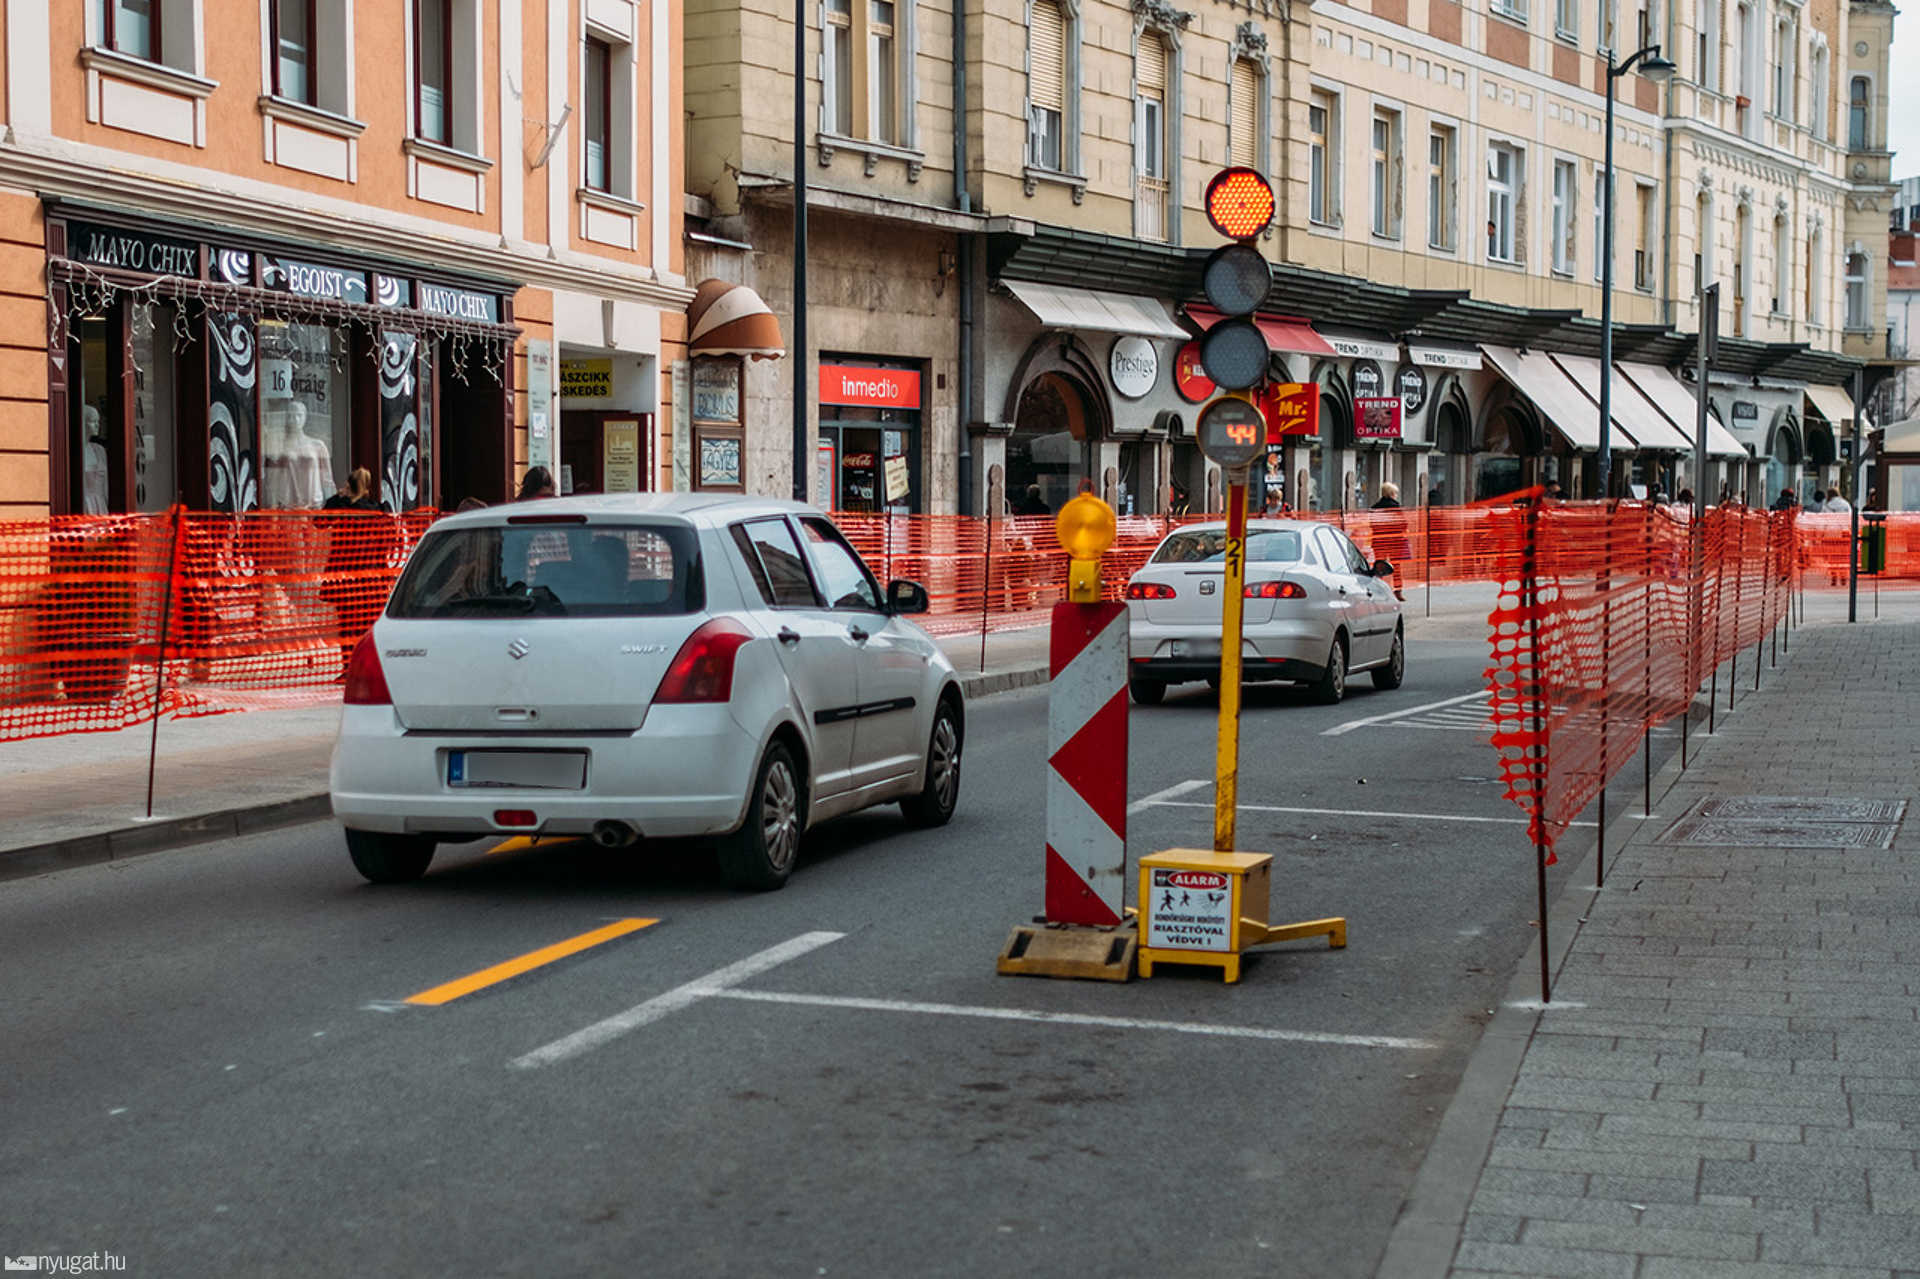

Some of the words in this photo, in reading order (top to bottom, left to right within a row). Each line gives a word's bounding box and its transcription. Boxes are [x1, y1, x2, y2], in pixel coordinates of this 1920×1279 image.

[86, 233, 145, 269] MAYO
[148, 243, 195, 276] CHIX
[288, 264, 343, 298] EGOIST
[421, 287, 458, 316] MAYO
[459, 294, 489, 320] CHIX
[1334, 343, 1359, 355] TREND
[1115, 351, 1155, 379] Prestige
[1423, 353, 1447, 364] TREND
[272, 370, 286, 392] 16
[1355, 372, 1379, 384] TREND
[841, 375, 899, 399] inmedio
[1357, 400, 1400, 409] TREND
[1226, 423, 1257, 446] 44
[1356, 426, 1399, 435] OPTIKA
[1175, 874, 1220, 886] ALARM
[1154, 925, 1224, 935] RIASZTÓVAL
